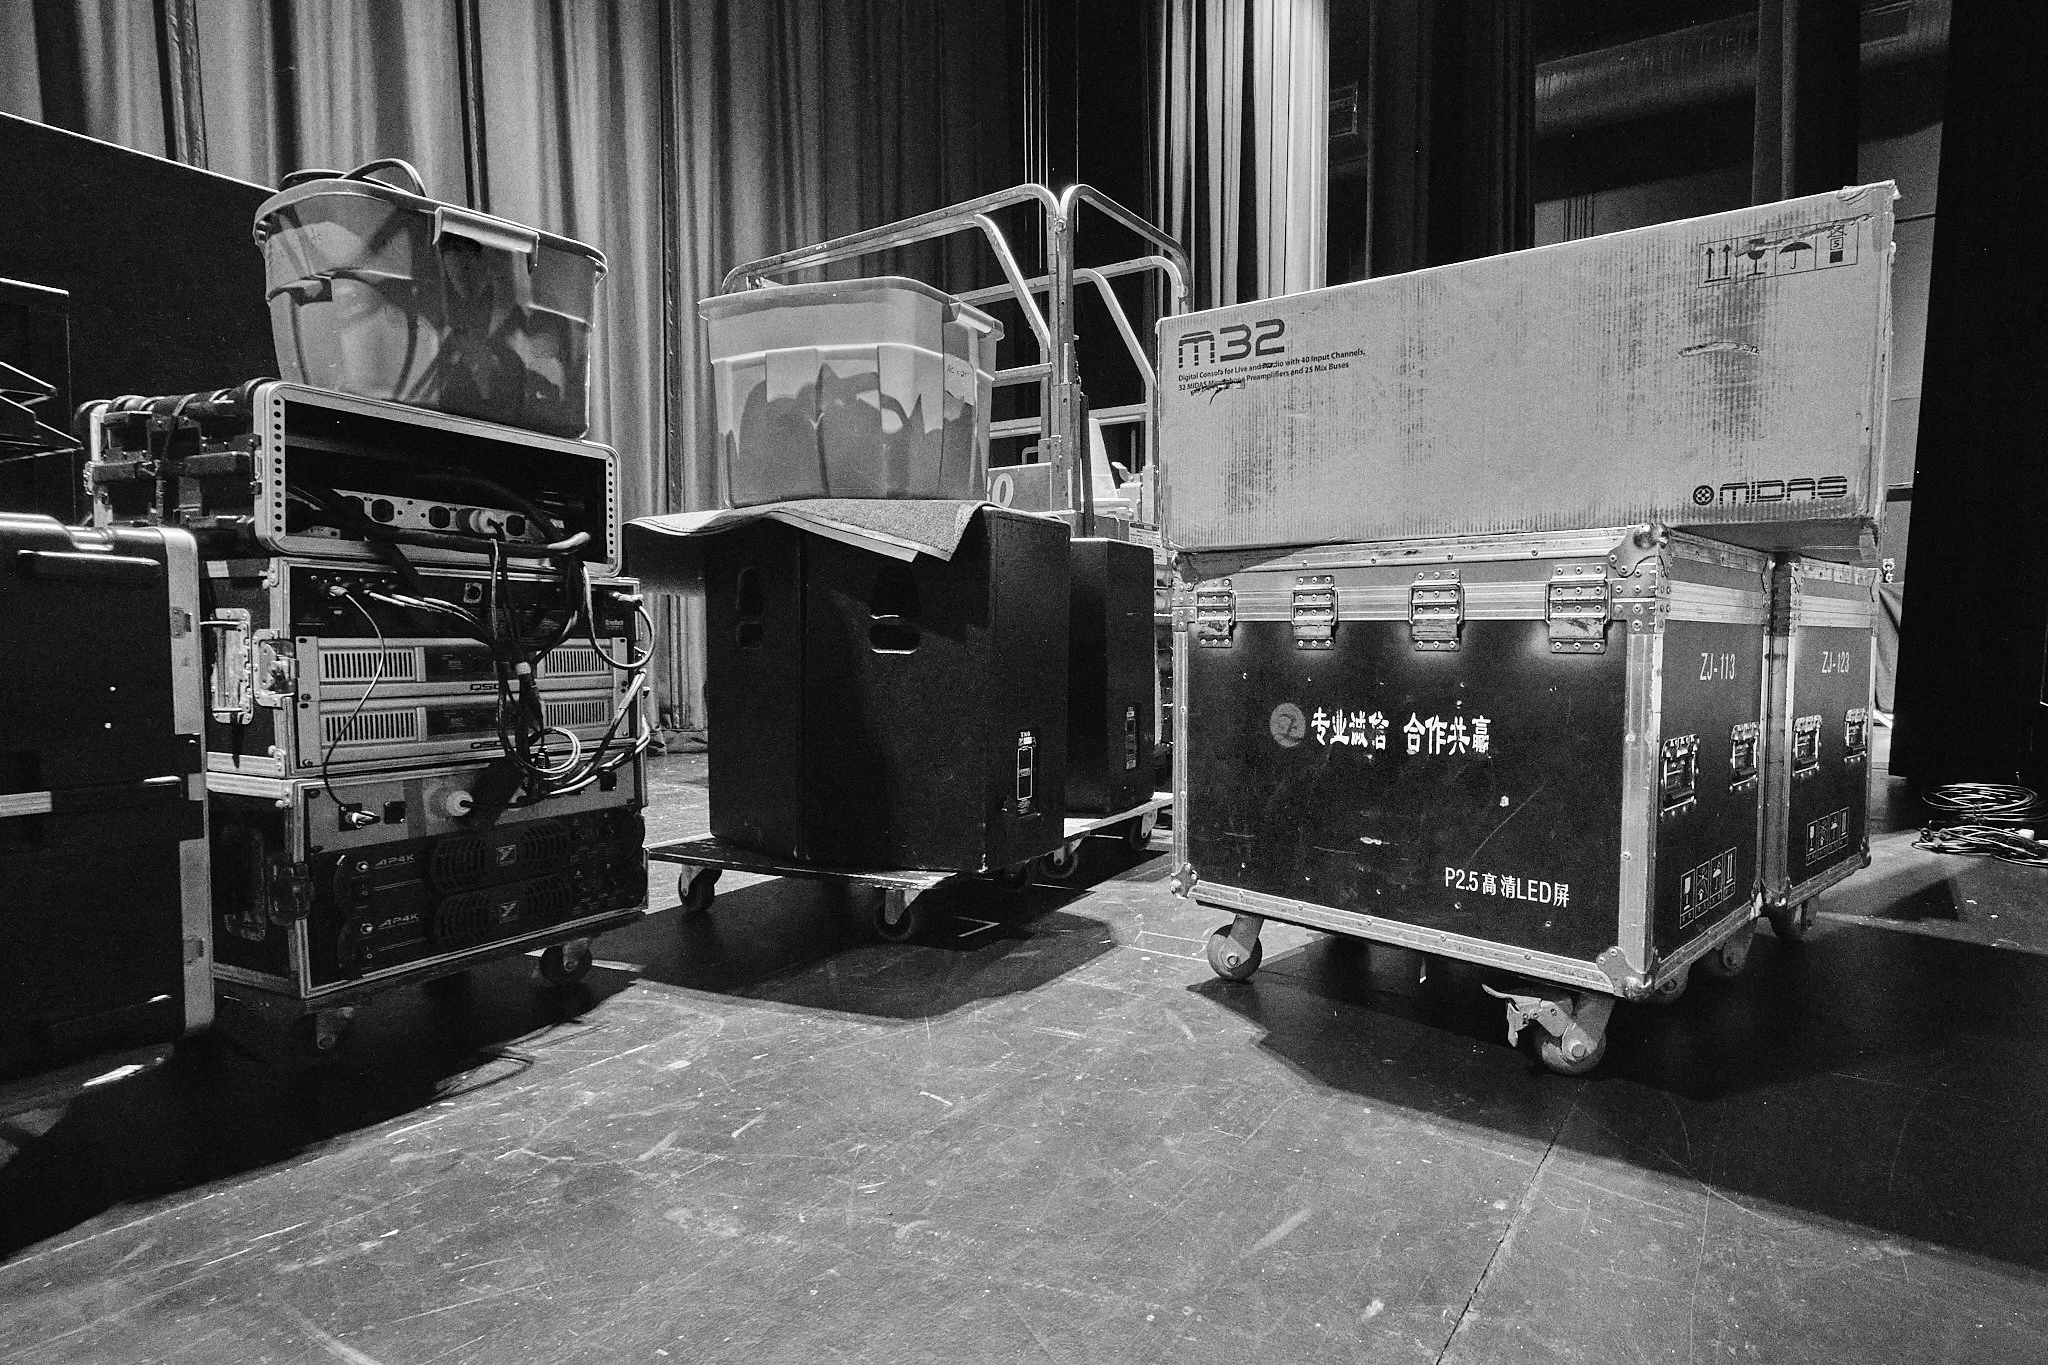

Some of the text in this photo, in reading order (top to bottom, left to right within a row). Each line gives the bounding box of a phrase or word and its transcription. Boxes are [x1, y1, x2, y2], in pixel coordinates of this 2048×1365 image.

[1178, 373, 1198, 382] Digital
[1199, 369, 1223, 379] Console
[1235, 365, 1247, 373] Live
[1249, 363, 1262, 371] and
[1262, 360, 1284, 369] dio
[1285, 357, 1300, 366] with
[1311, 354, 1330, 363] Input
[1187, 380, 1207, 390] MIDAS
[1246, 369, 1289, 382] Preamplifiers
[1290, 367, 1304, 376] and
[1305, 366, 1313, 374] 25
[1314, 364, 1327, 372] Mix
[1328, 362, 1349, 371] Buses
[1719, 476, 1848, 505] MIDAS
[1699, 652, 1736, 681] ZJ-113
[1821, 651, 1850, 674] ZJ-123
[1403, 712, 1492, 755] 合作共赢
[1445, 866, 1570, 908] P2.5高清LED屏
[379, 913, 419, 928] AP4K
